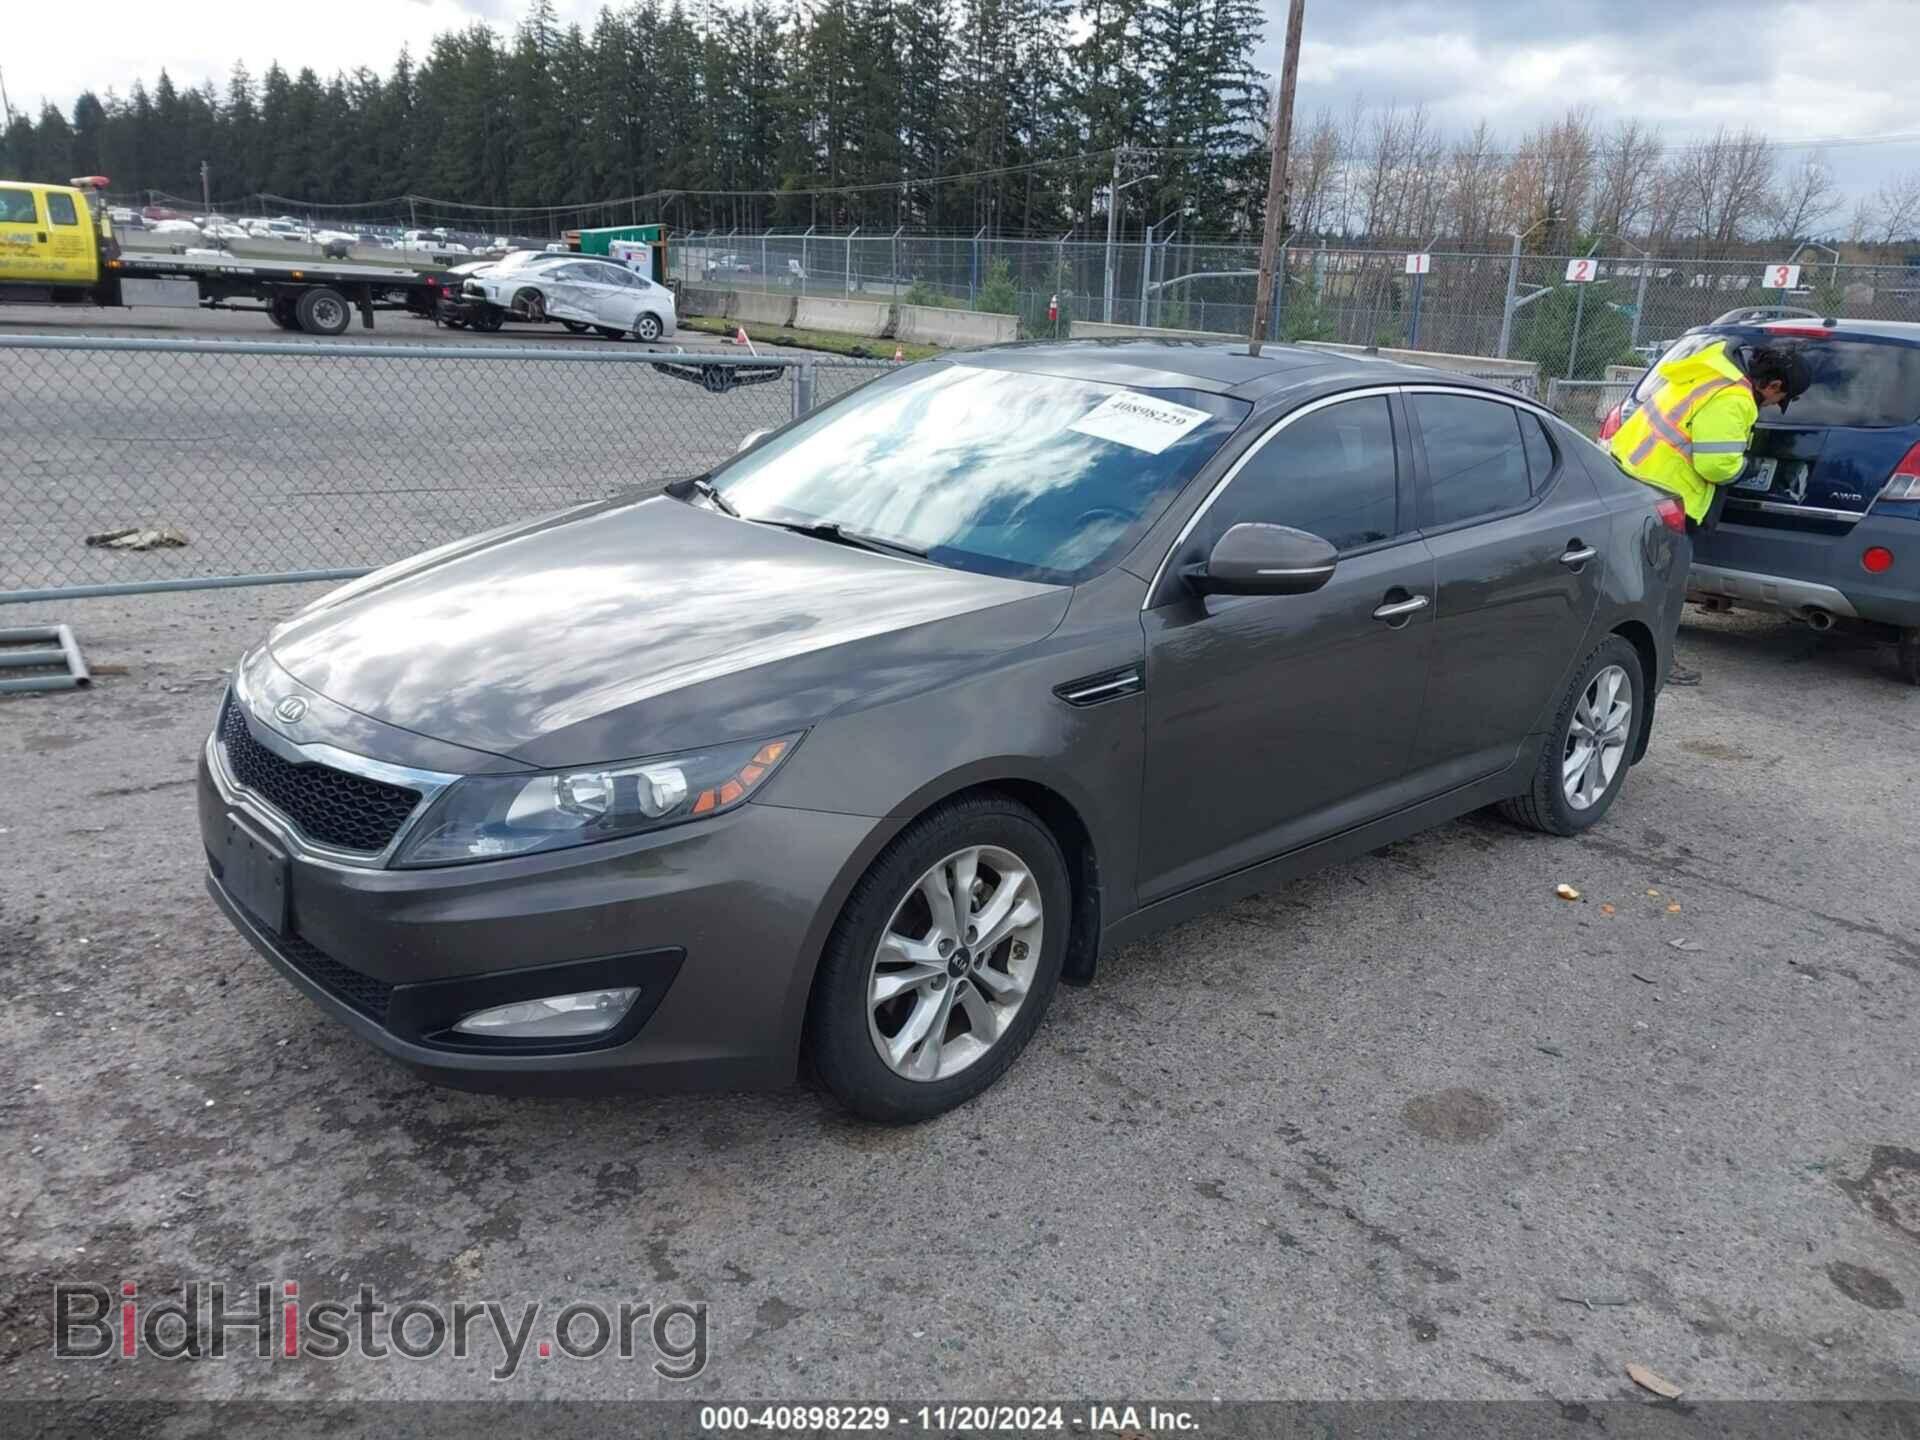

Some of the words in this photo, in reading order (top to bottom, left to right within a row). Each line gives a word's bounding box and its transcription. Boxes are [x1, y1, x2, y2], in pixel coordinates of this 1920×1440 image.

[1415, 255, 1421, 272] 1
[1575, 261, 1588, 280] 2
[1774, 266, 1789, 287] 3
[1111, 402, 1187, 425] 40898229
[1831, 492, 1862, 501] AWD
